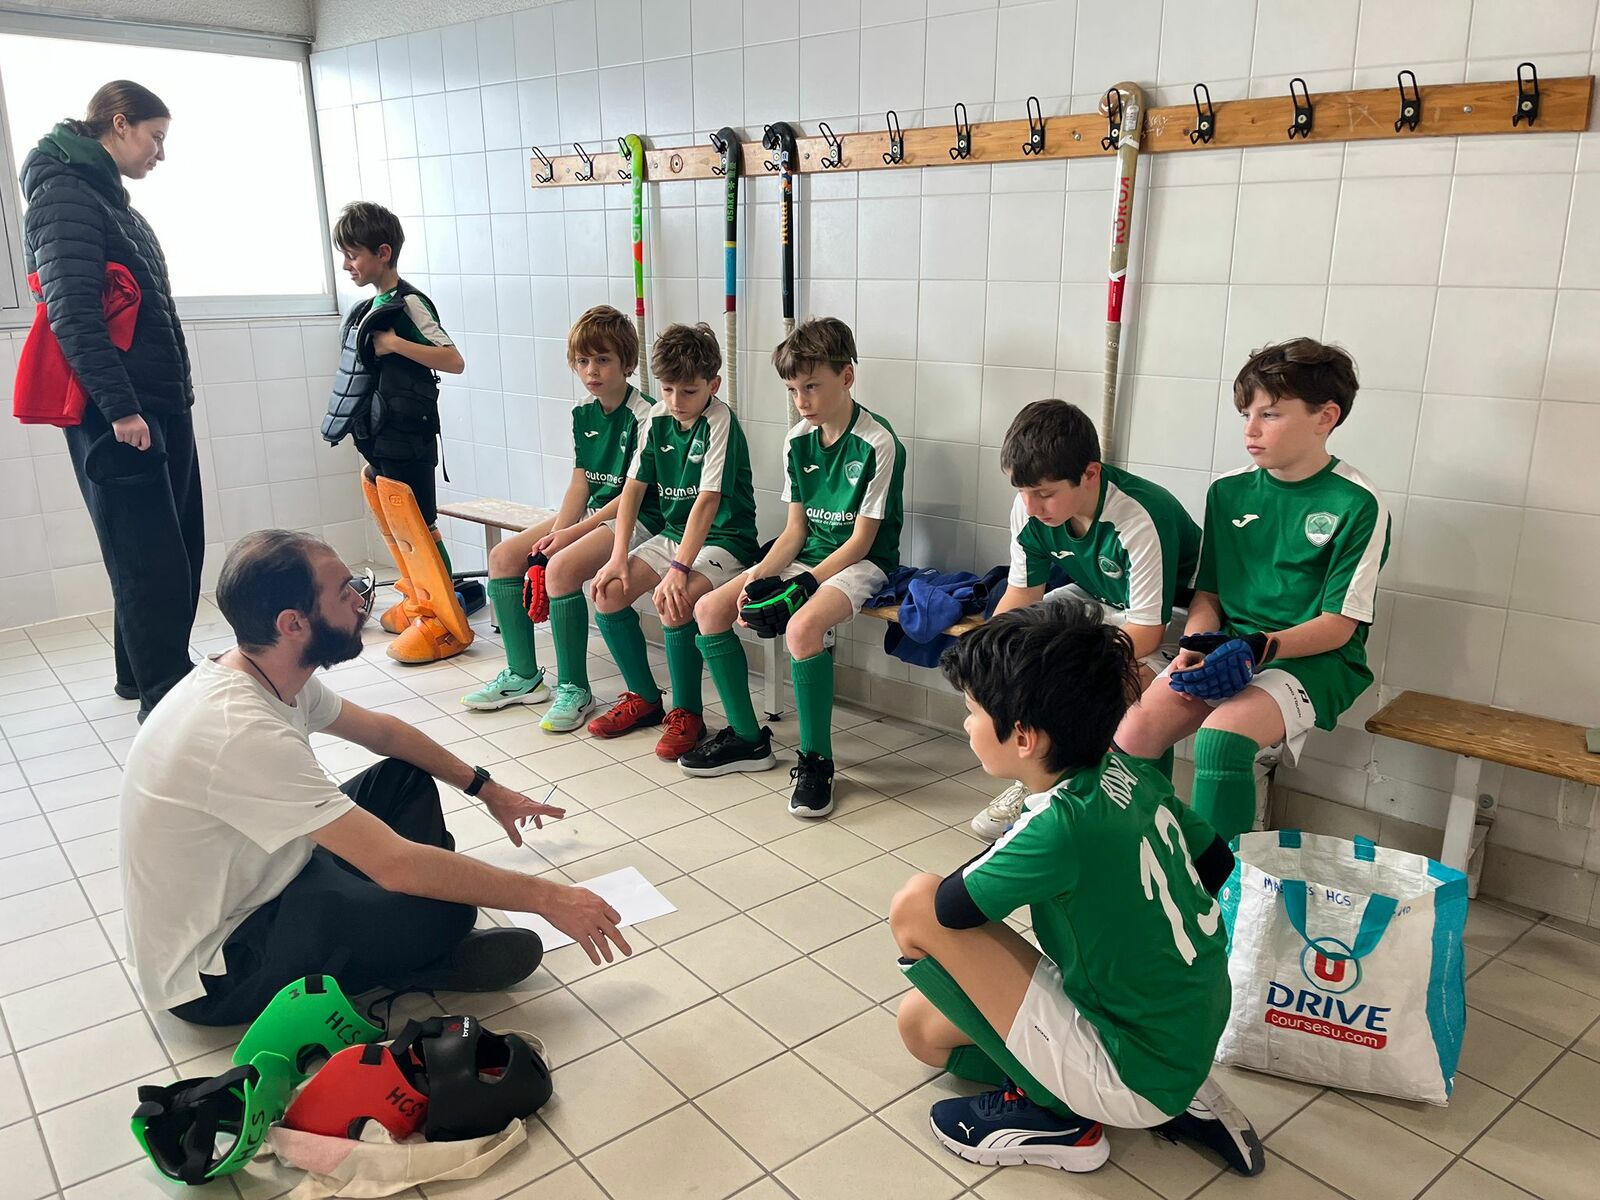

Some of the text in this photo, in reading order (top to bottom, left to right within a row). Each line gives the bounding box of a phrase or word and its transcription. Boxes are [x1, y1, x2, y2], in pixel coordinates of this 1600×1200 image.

[727, 191, 735, 222] OSAKA
[1326, 889, 1352, 907] HCS
[1314, 951, 1346, 983] U
[1266, 981, 1392, 1033] DRIVE
[325, 1010, 361, 1045] HCS
[1271, 1013, 1378, 1048] coursesu.com
[385, 1086, 424, 1118] HCS
[232, 1110, 265, 1164] HCS
